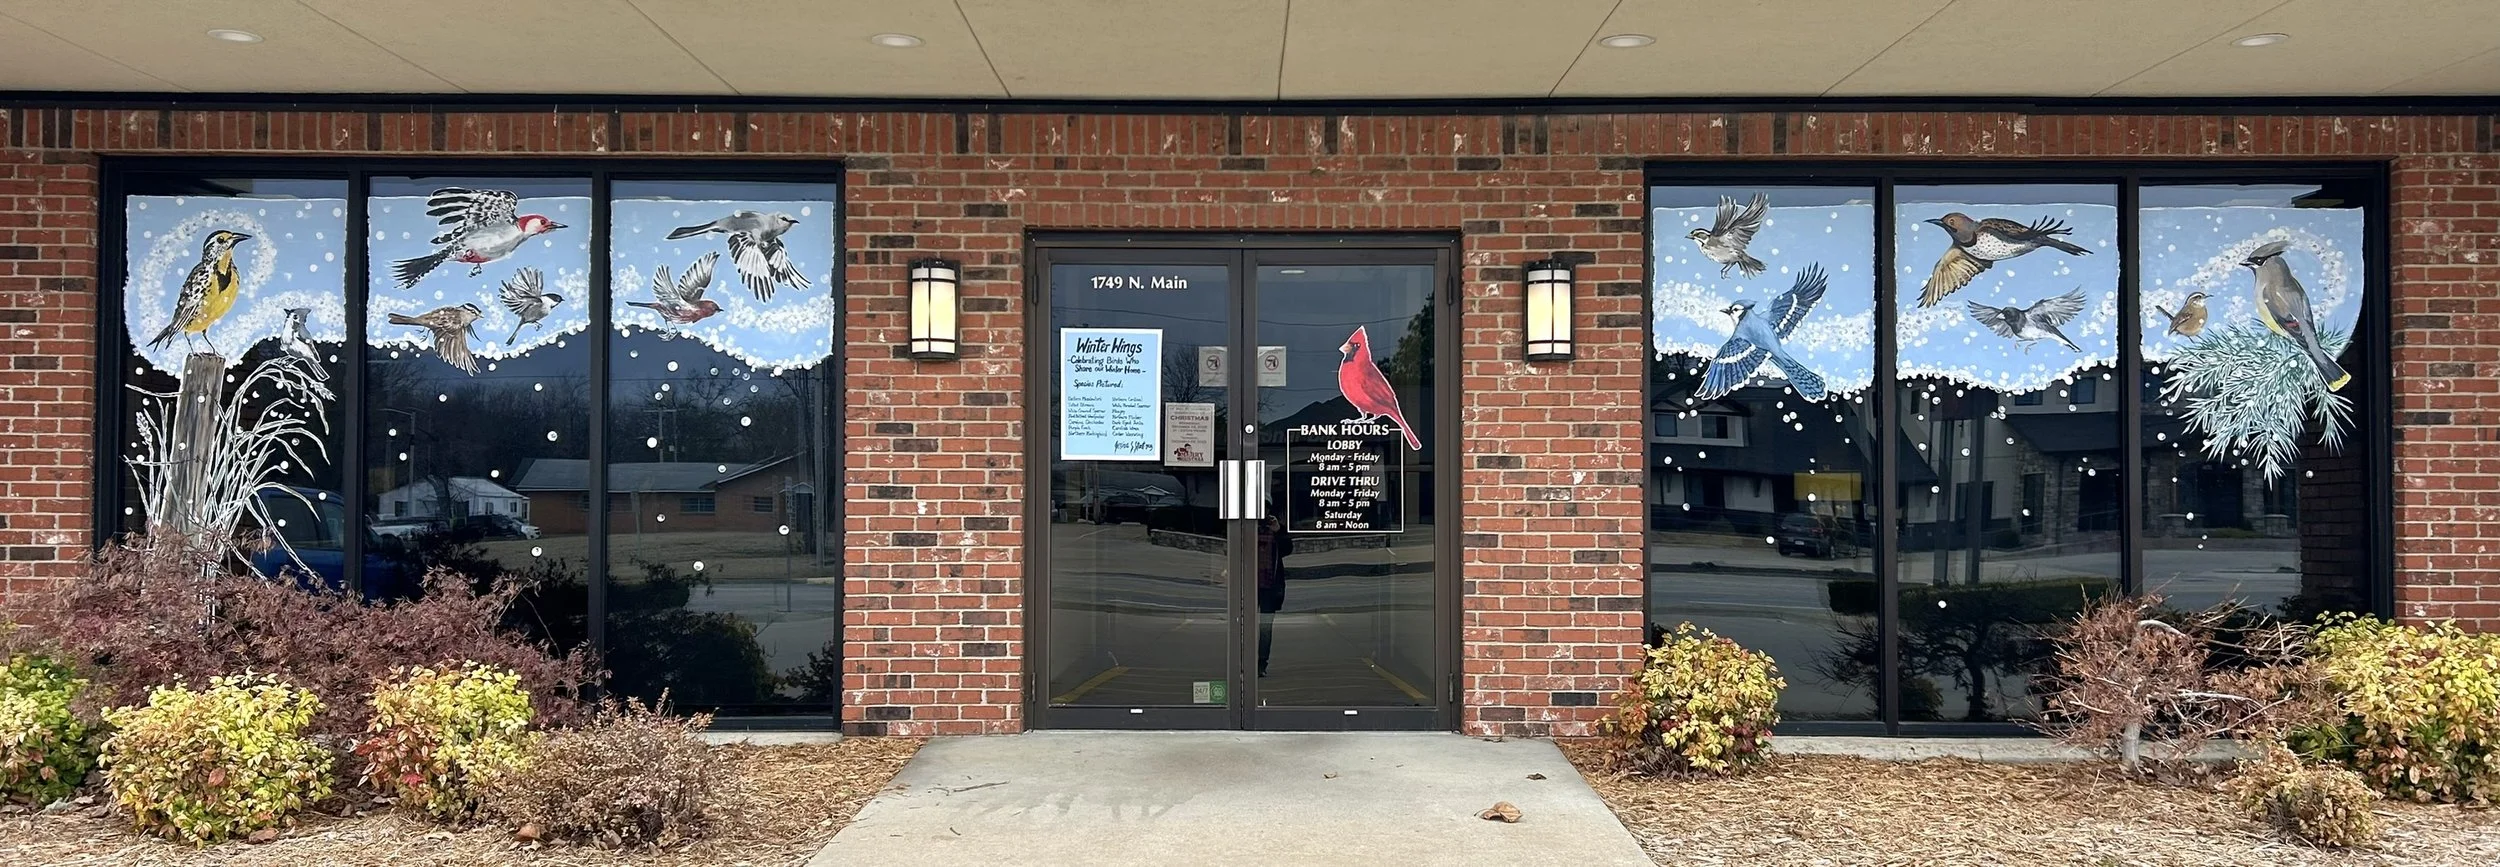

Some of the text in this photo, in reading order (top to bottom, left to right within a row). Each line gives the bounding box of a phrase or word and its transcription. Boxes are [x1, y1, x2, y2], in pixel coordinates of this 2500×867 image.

[1091, 276, 1187, 289] 1749 N. Main
[1076, 337, 1143, 357] Winter Wings
[1106, 356, 1123, 364] Birds
[1074, 364, 1092, 373] Share
[1105, 365, 1124, 373] Winter
[1124, 365, 1140, 374] Home
[1073, 379, 1094, 389] Species
[1300, 424, 1390, 436] BANK HOURS
[1327, 440, 1363, 450] LOBBY
[1310, 452, 1345, 463] Monday
[1353, 452, 1380, 463] Friday
[1319, 463, 1325, 471] 8
[1348, 463, 1354, 471] 5
[1355, 464, 1370, 472] pm
[1311, 476, 1380, 486] DRIVE THRU
[1310, 489, 1345, 499] Monday
[1353, 489, 1380, 499] Friday
[1319, 499, 1325, 507] 8
[1348, 499, 1354, 507] 5
[1355, 500, 1370, 509] pm
[1324, 511, 1362, 520] Saturday
[1316, 521, 1322, 529] 8
[1345, 521, 1369, 529] Noon
